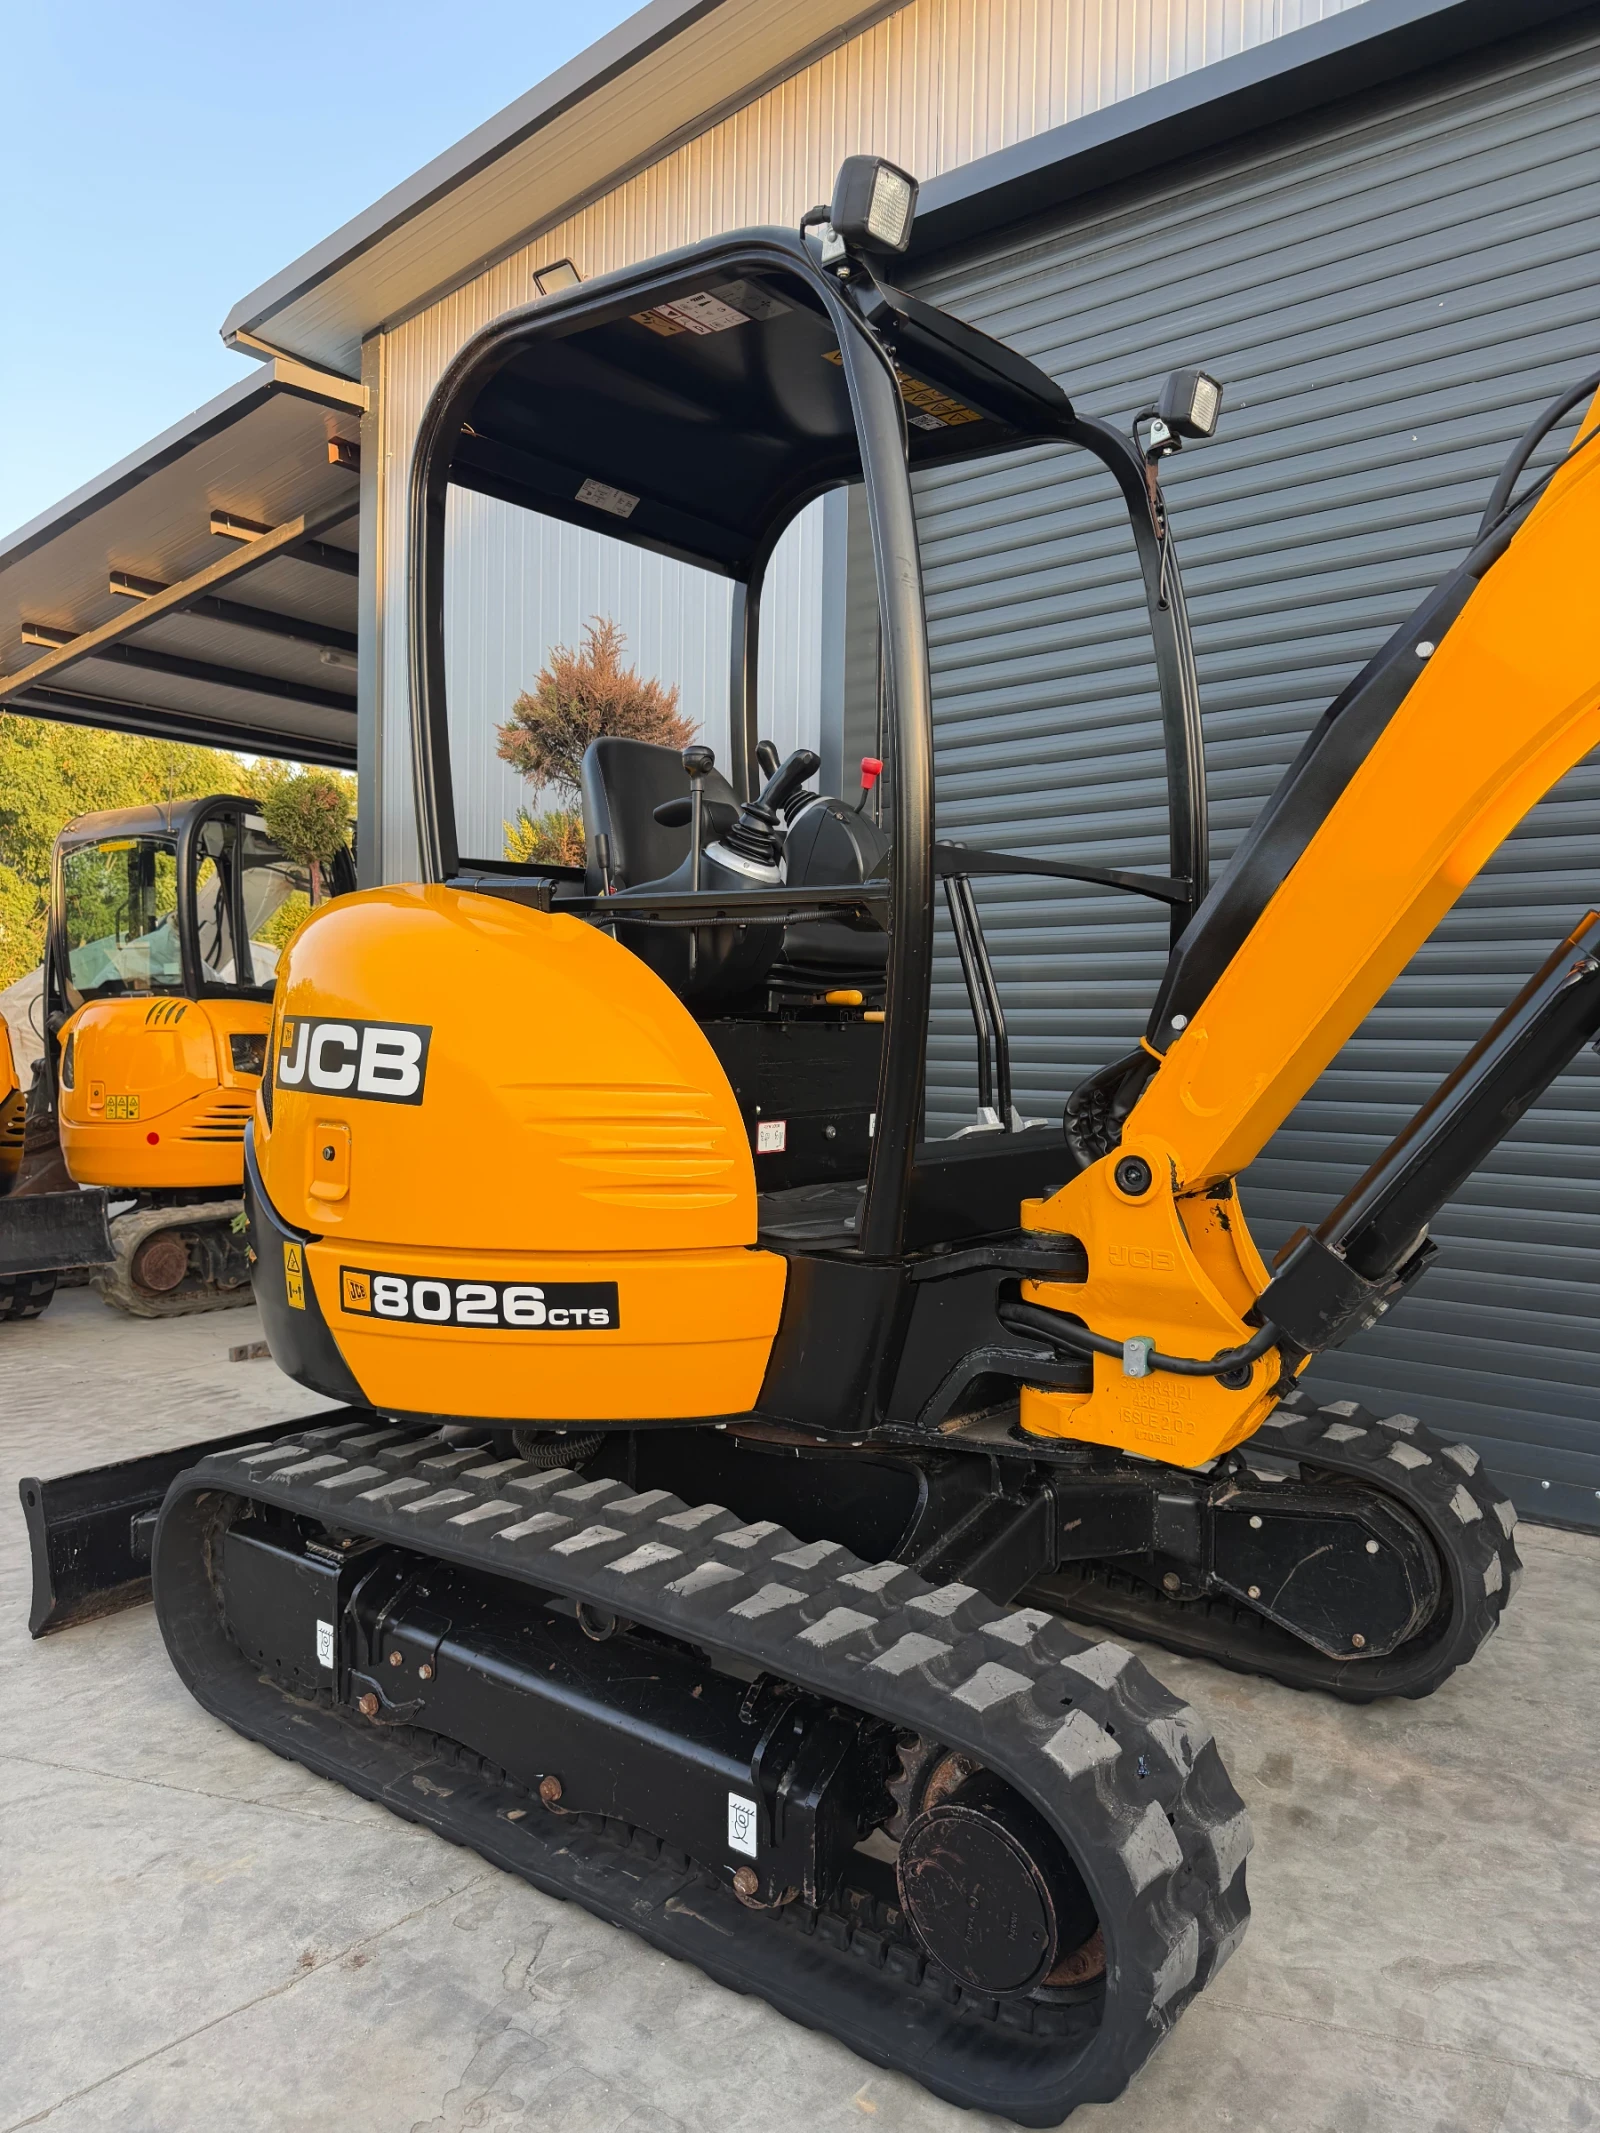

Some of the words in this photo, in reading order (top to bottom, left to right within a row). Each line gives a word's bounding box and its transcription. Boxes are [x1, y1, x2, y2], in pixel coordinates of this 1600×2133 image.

[279, 1022, 422, 1097] JCB
[1108, 1245, 1175, 1272] JCB
[349, 1280, 367, 1300] JCB
[373, 1275, 547, 1326] 8026
[548, 1308, 610, 1326] CTS
